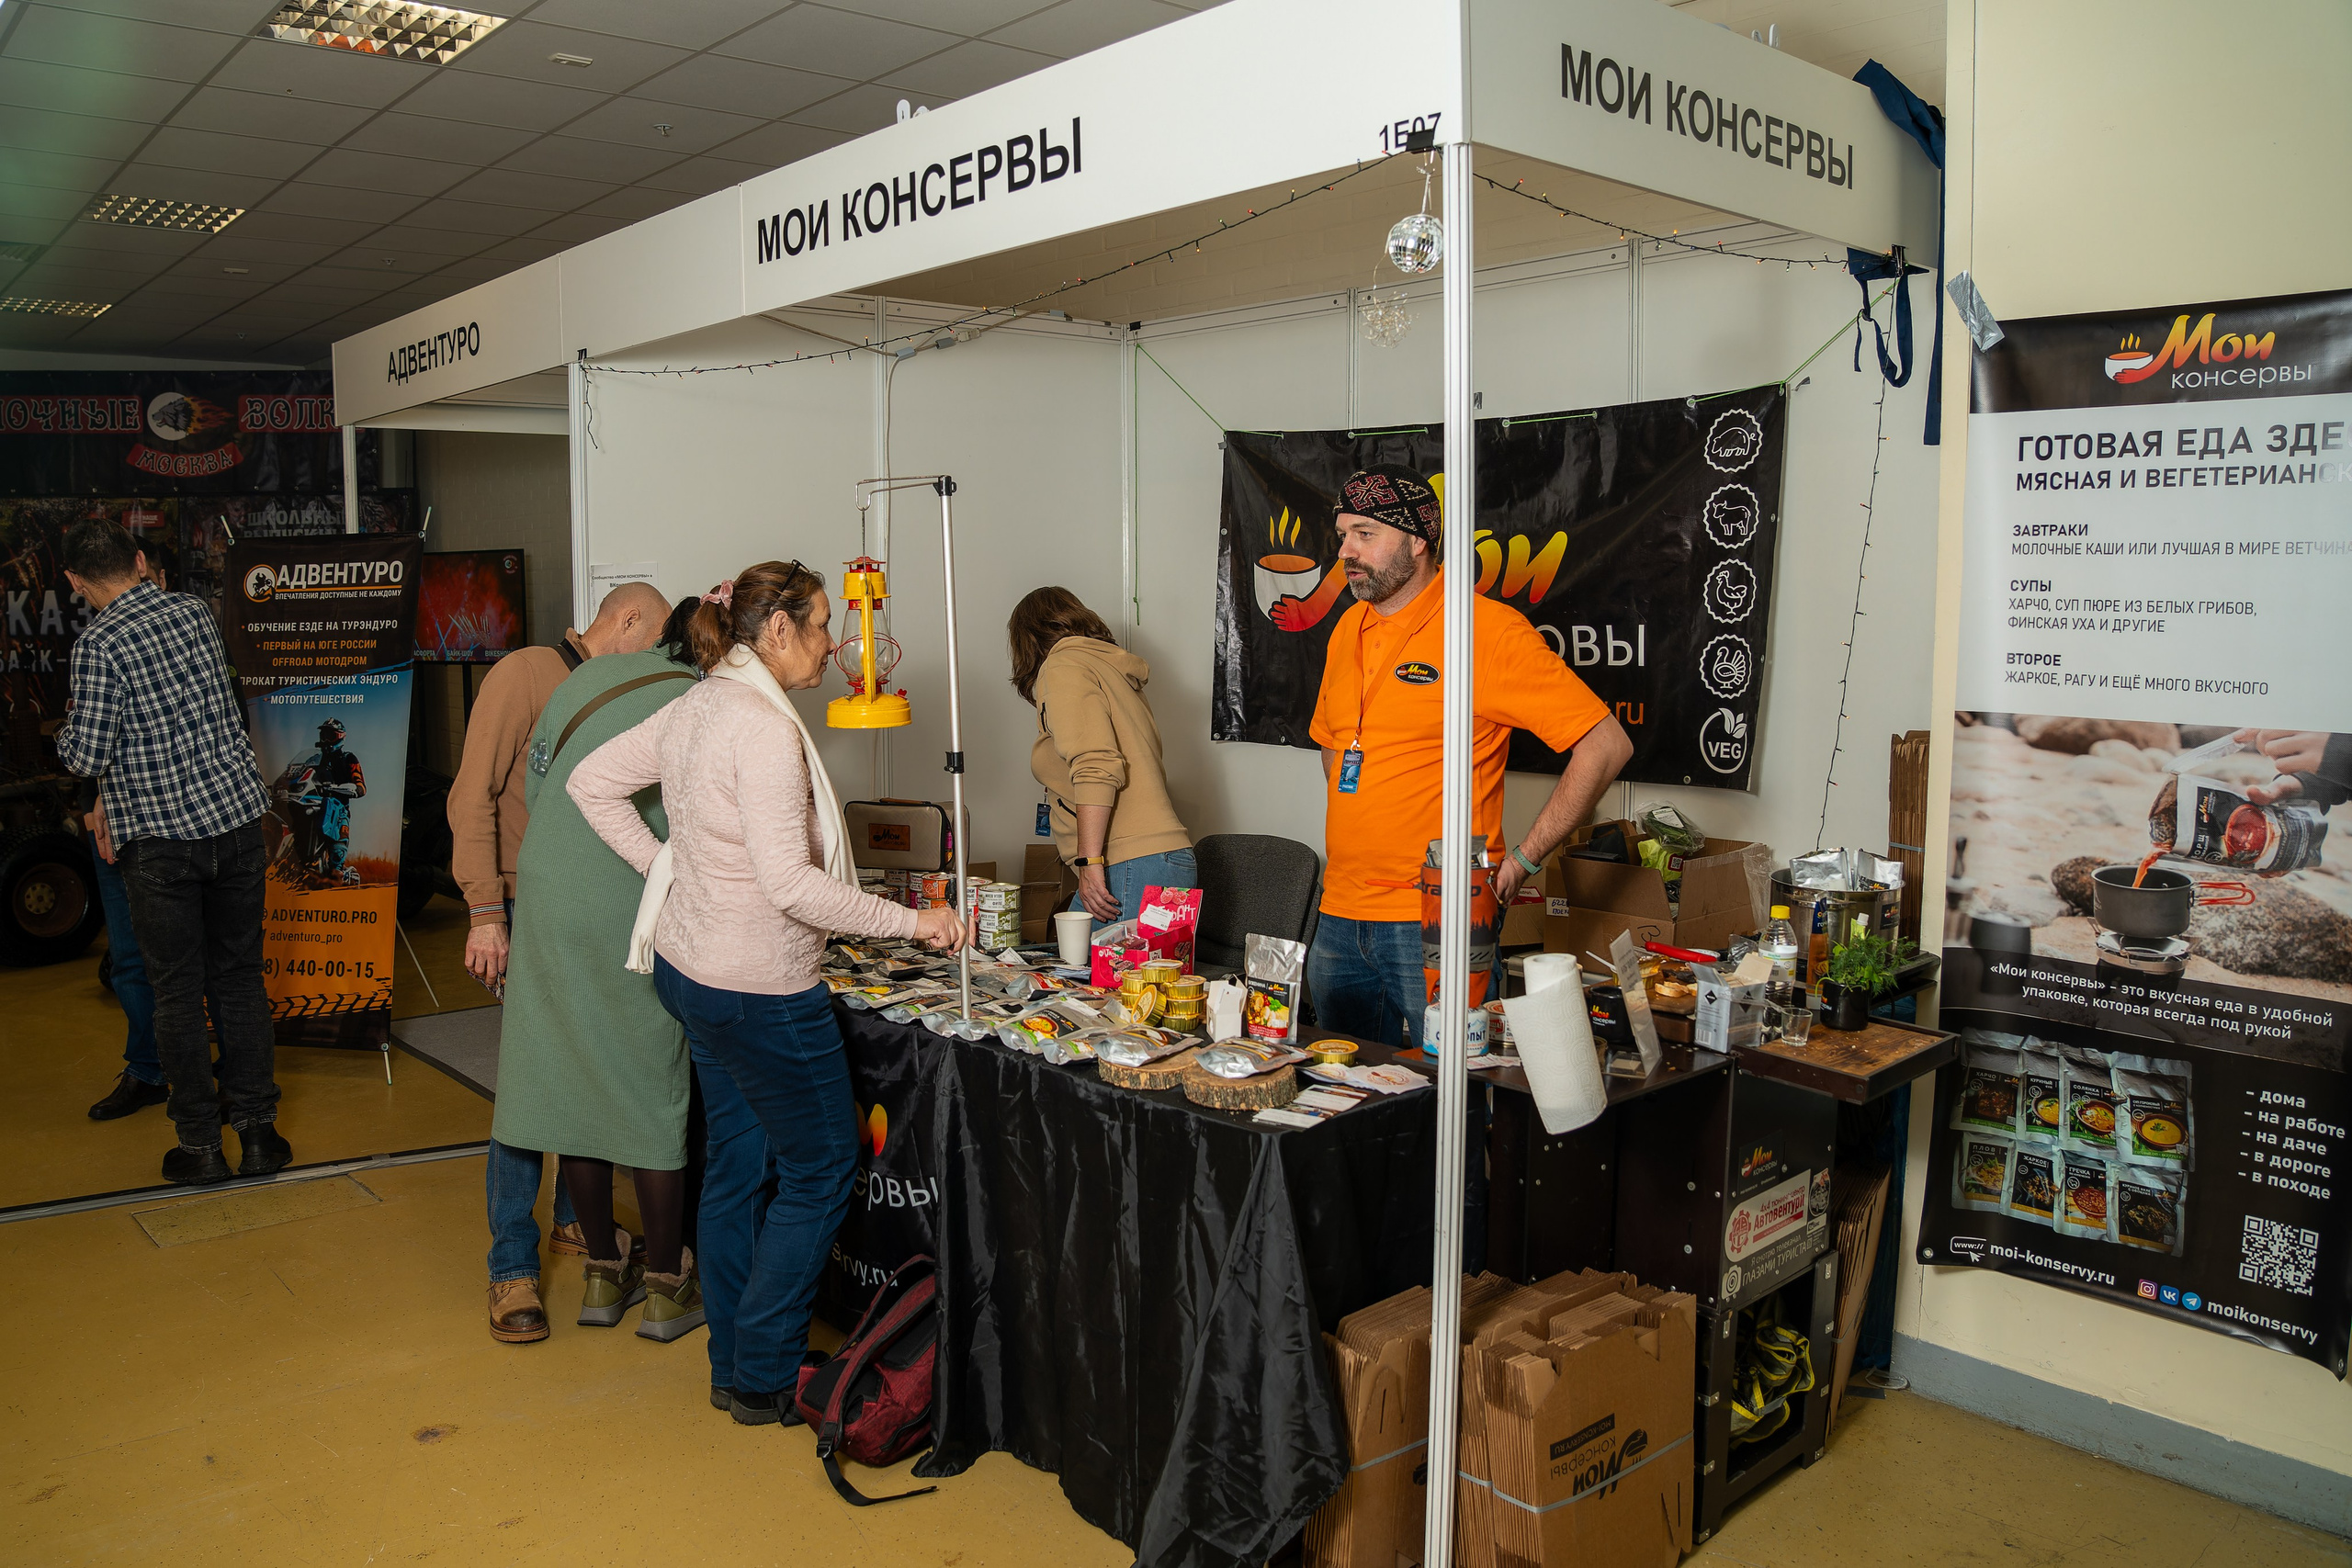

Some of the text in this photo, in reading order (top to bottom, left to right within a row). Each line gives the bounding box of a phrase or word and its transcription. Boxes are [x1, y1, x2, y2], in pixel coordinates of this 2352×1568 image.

[1561, 42, 1853, 190] МОИ КОНСЕРВЫ
[757, 116, 1082, 265] МОИ КОНСЕРВЫ
[2157, 313, 2276, 368] Мои
[388, 321, 481, 387] АДВЕНТУРО
[2171, 364, 2312, 390] консервы
[0, 398, 336, 432] ОЧНЫЕ ВОЛК
[2018, 421, 2352, 462] ГОТОВАЯ ЕДА ЗДЕ
[137, 448, 233, 475] МОСКВА
[2016, 469, 2111, 491] МЯСНАЯ
[2120, 468, 2136, 489] И
[2012, 524, 2088, 536] ЗАВТРАКИ
[2011, 543, 2082, 556] МОЛОЧНЫЕ
[2086, 542, 2124, 556] КАШИ
[2128, 542, 2157, 555] ИЛИ
[2161, 542, 2221, 555] ЛУЧШАЯ
[2224, 542, 2234, 555] В
[2238, 542, 2280, 555] МИРЕ
[277, 559, 404, 590] АДВЕНТУРО
[2010, 580, 2052, 592] СУПЫ
[275, 592, 319, 600] ВПЕЧАТЛЕНИЯ
[320, 591, 358, 600] ДОСТУПНЫЕ
[368, 589, 402, 598] КАЖДОМУ
[2008, 598, 2257, 616] ХАРЧО, СУП ПЮРЕ ИЗ БЕЛЫХ ГРИБОВ,
[247, 619, 398, 632] ОБУЧЕНИЕ ЕЗДЕ НА ТУРЭНДУРО
[2007, 615, 2165, 633] ФИНСКАЯ УХА И ДРУГИЕ
[263, 638, 377, 650] ПЕРВЫЙ НА ЮГЕ РОССИИ
[272, 656, 368, 667] OFFROAD МОТОДРОМ
[2006, 653, 2062, 666] ВТОРОЕ
[278, 674, 356, 686] ТУРИСТИЧЕСКИХ
[360, 674, 398, 686] ЭНДУРО
[2005, 671, 2268, 695] ЖАРКОЕ, РАГУ И ЕЩЁ МНОГО ВКУСНОГО
[270, 694, 364, 705] МОТОПУТЕШЕСТВИЯ
[1707, 741, 1742, 760] VEG
[270, 908, 378, 924] ADVENTURO.PRO
[269, 930, 343, 945] adventuro_pro
[286, 959, 374, 978] 440-00-15
[1990, 963, 2028, 977] «Мои
[2030, 970, 2106, 989] консервы»
[2120, 985, 2144, 998] это
[2149, 989, 2210, 1008] вкусная
[2214, 998, 2244, 1013] еда
[2248, 1004, 2258, 1015] в
[2262, 1007, 2333, 1027] удобной
[2022, 986, 2291, 1039] упаковке, которая всегда под рукой
[2259, 1090, 2305, 1109] дома
[2258, 1111, 2346, 1139] на работе
[2256, 1131, 2327, 1156] на даче
[2254, 1151, 2331, 1178] в дороге
[2252, 1171, 2331, 1200] в походе
[1742, 1240, 1807, 1286] ГЛАЗАМИ ТУРИСТА
[1990, 1243, 2115, 1285] moi-konservy.ru
[2207, 1301, 2318, 1346] moikonservy
[1550, 1435, 1616, 1480] консервы
